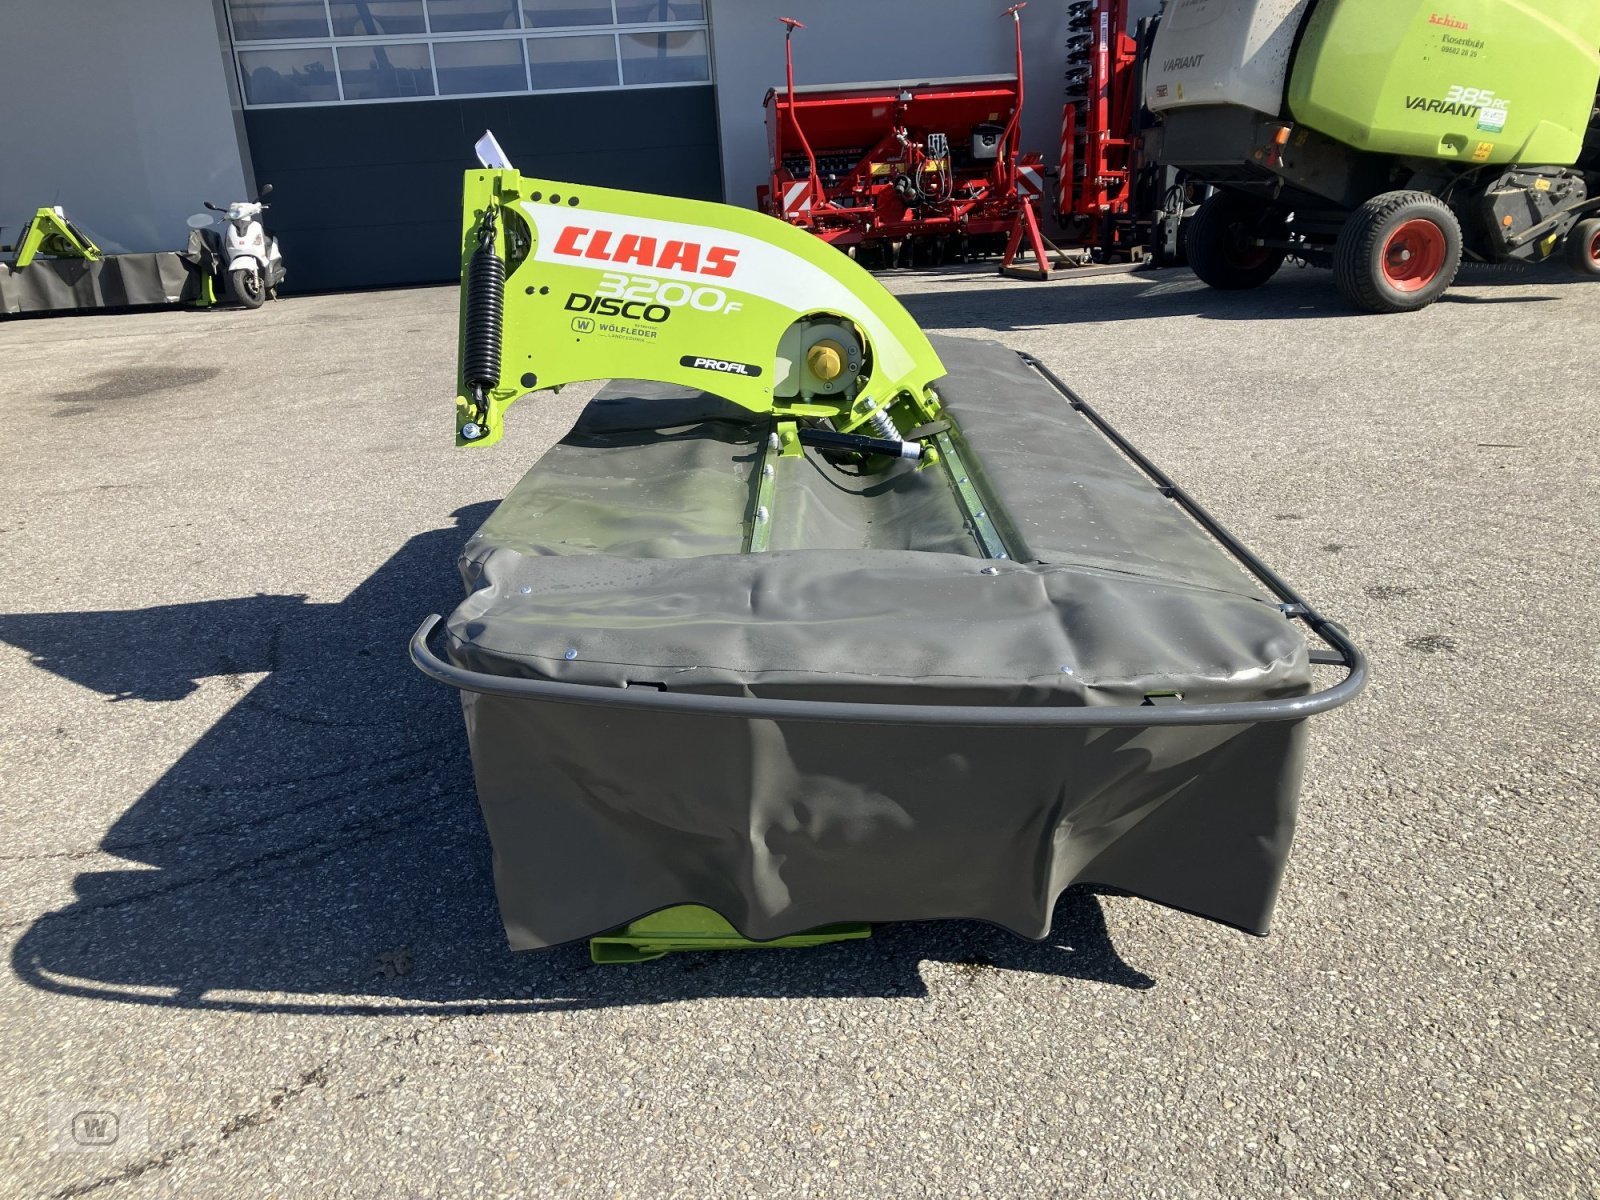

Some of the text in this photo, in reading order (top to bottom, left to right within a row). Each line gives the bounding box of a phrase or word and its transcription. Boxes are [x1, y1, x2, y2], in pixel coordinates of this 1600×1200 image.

[1163, 54, 1205, 72] VARIANT
[1405, 95, 1482, 118] VARIANT
[553, 226, 740, 278] CLAAS
[564, 293, 671, 323] DISCO
[577, 320, 590, 331] W
[599, 323, 657, 339] WÖLFLEDER
[693, 357, 749, 375] PROFIL
